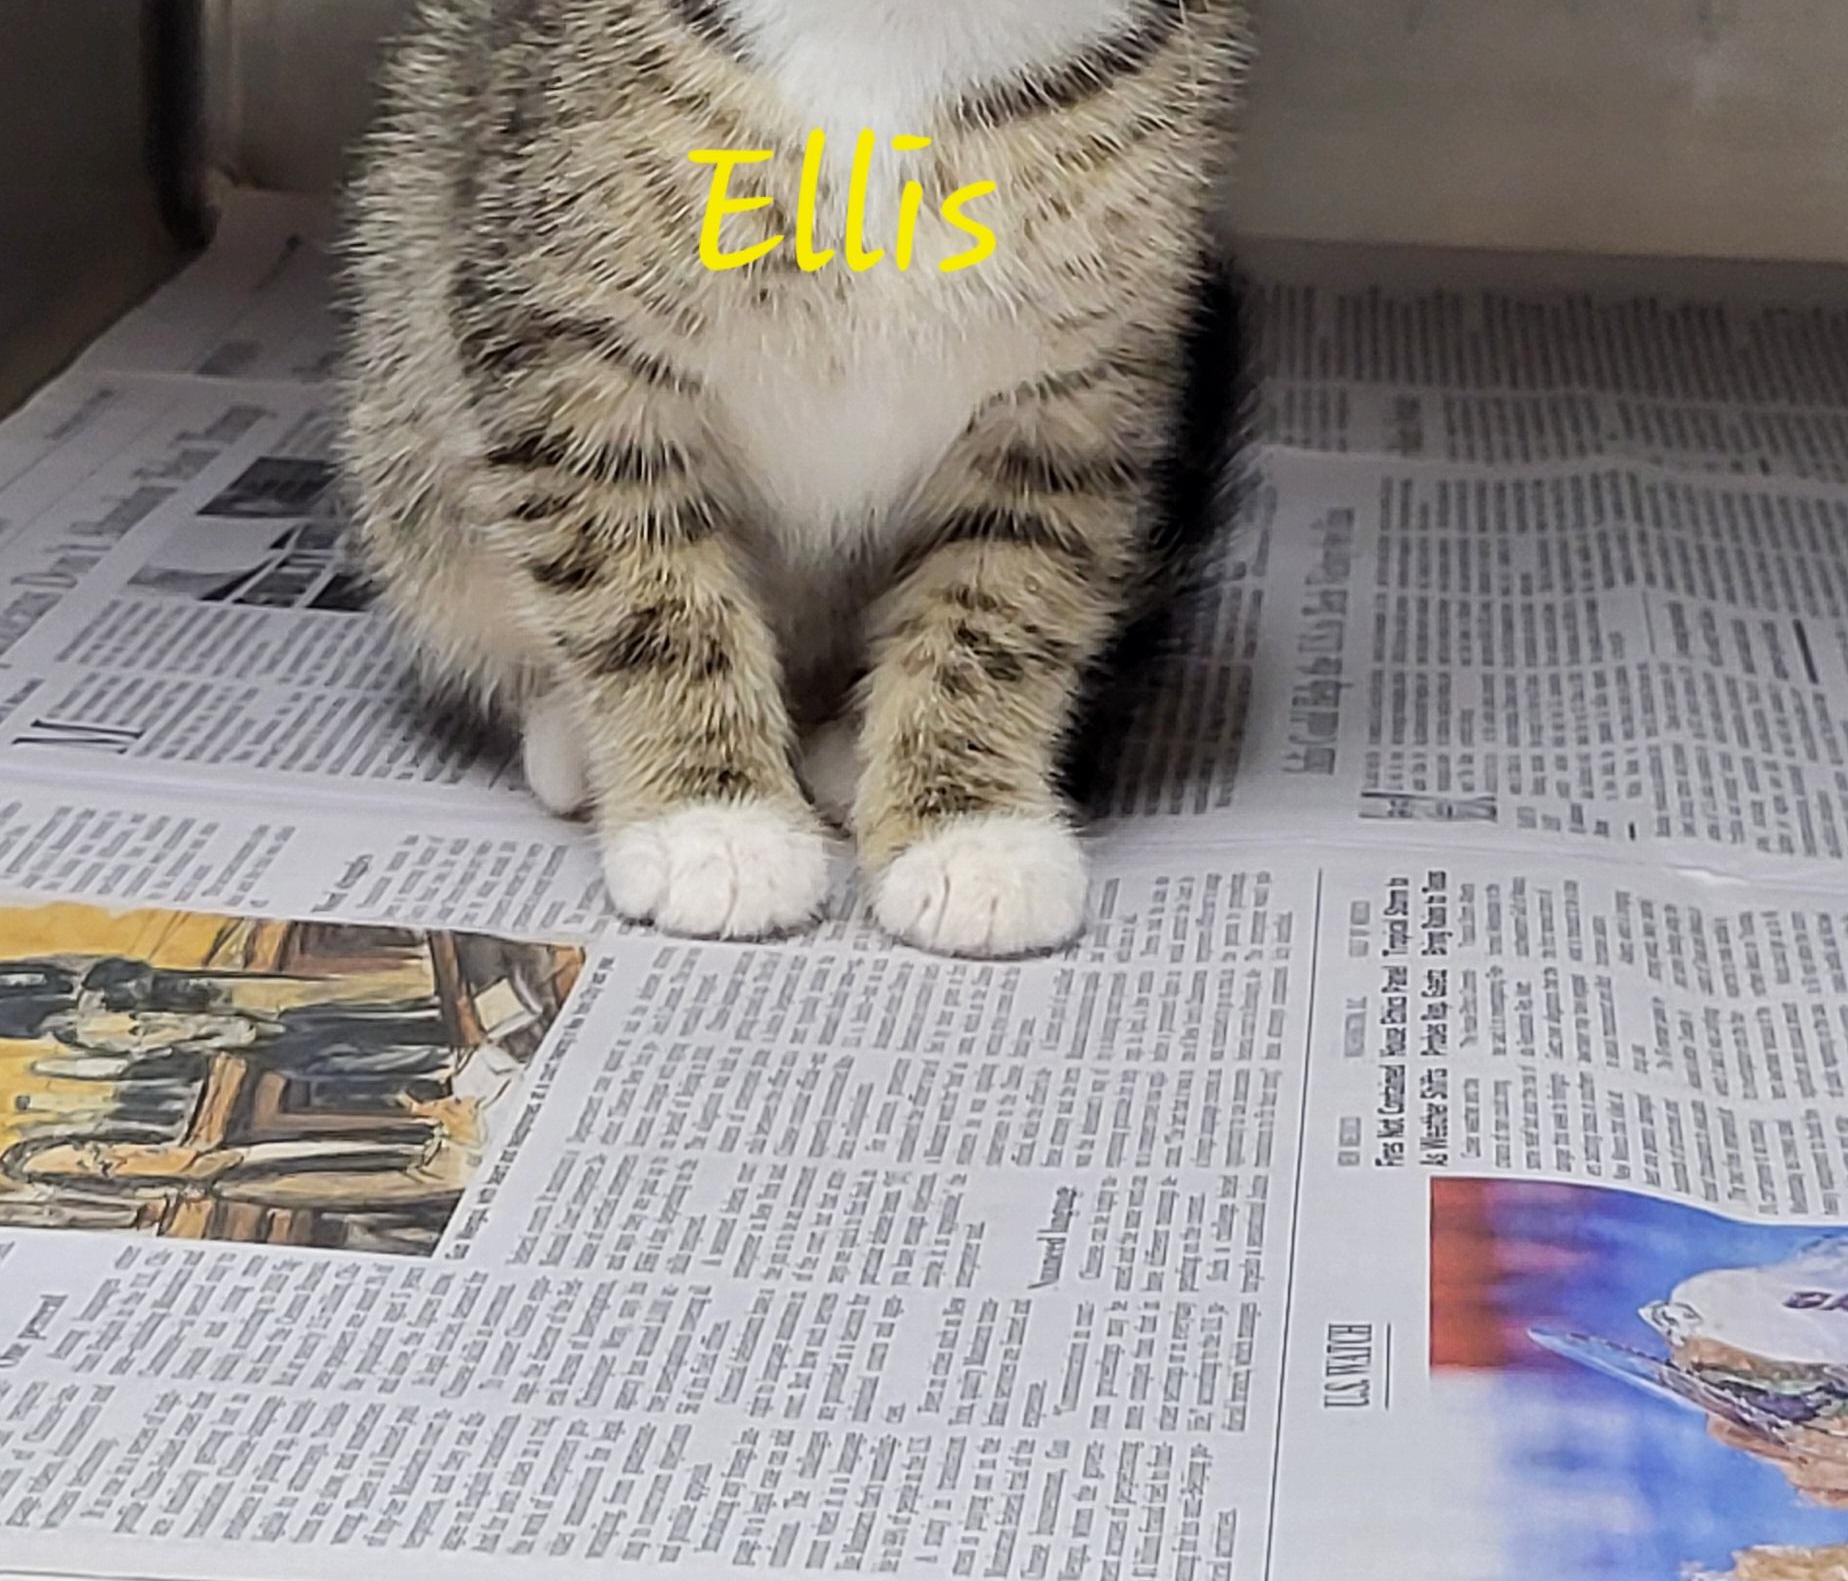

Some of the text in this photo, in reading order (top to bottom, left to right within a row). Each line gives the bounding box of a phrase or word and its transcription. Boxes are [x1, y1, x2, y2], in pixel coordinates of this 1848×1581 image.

[1376, 1117, 1405, 1138] Not
[1375, 1141, 1404, 1166] Fires
[1418, 1153, 1449, 1167] As
[1323, 1323, 1372, 1408] U.S. WATCH
